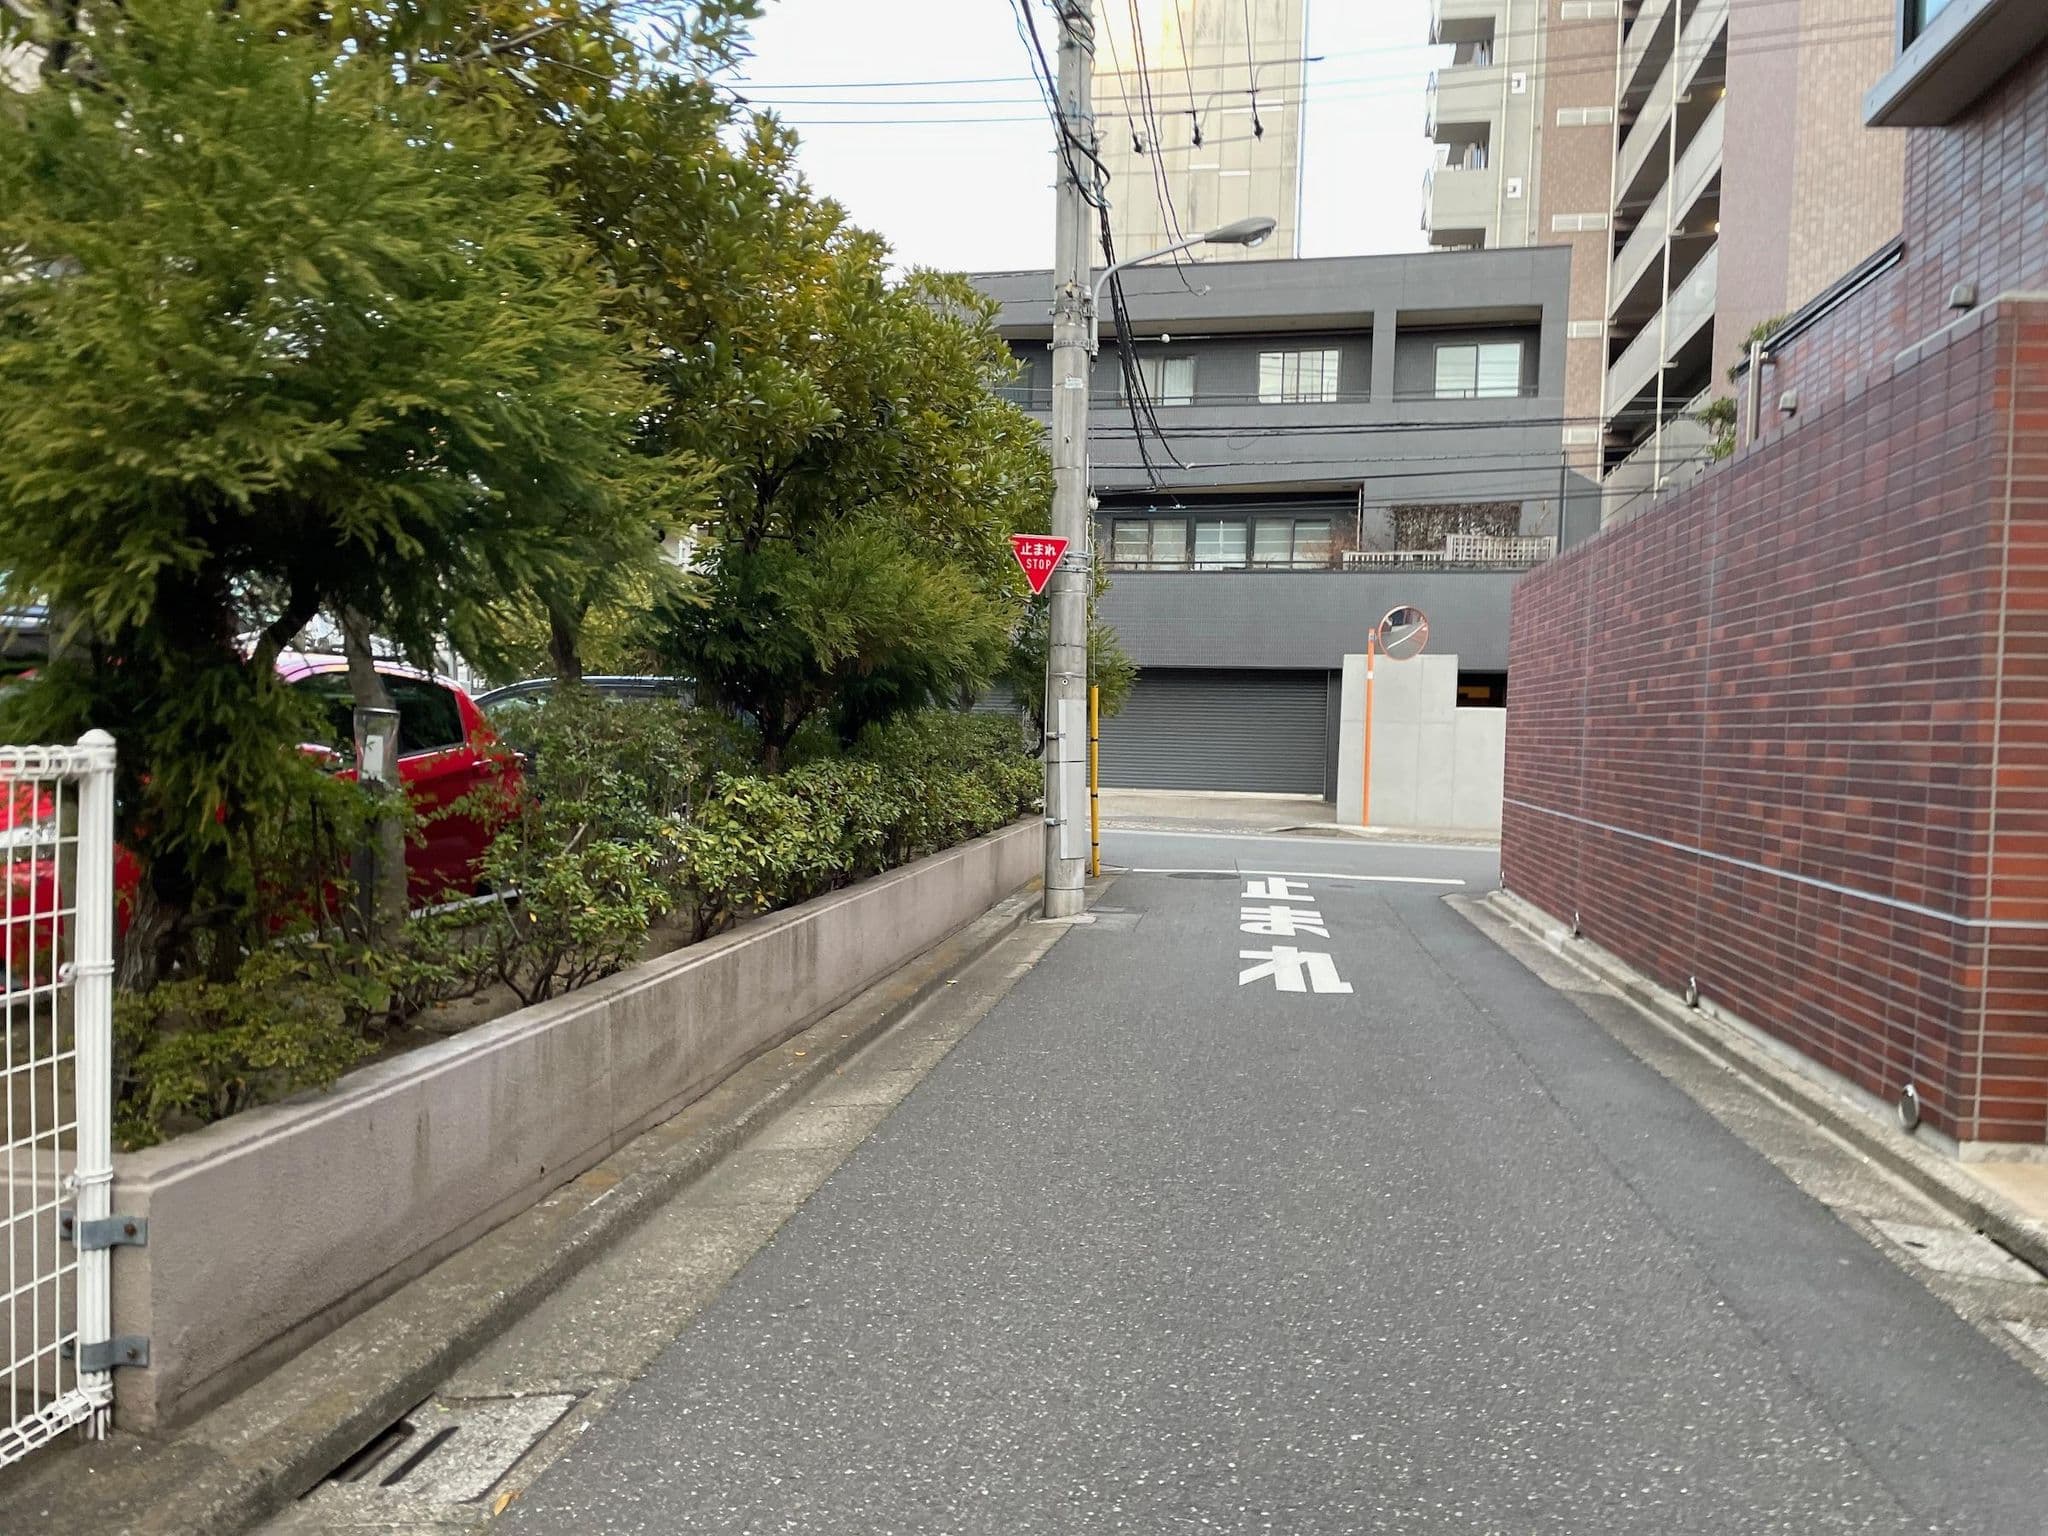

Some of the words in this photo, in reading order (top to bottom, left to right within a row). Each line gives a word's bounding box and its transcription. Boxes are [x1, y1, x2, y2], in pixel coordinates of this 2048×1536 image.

[1020, 542, 1057, 556] 止まれ
[1026, 558, 1051, 570] STOP
[1239, 877, 1353, 993] 止まれ
